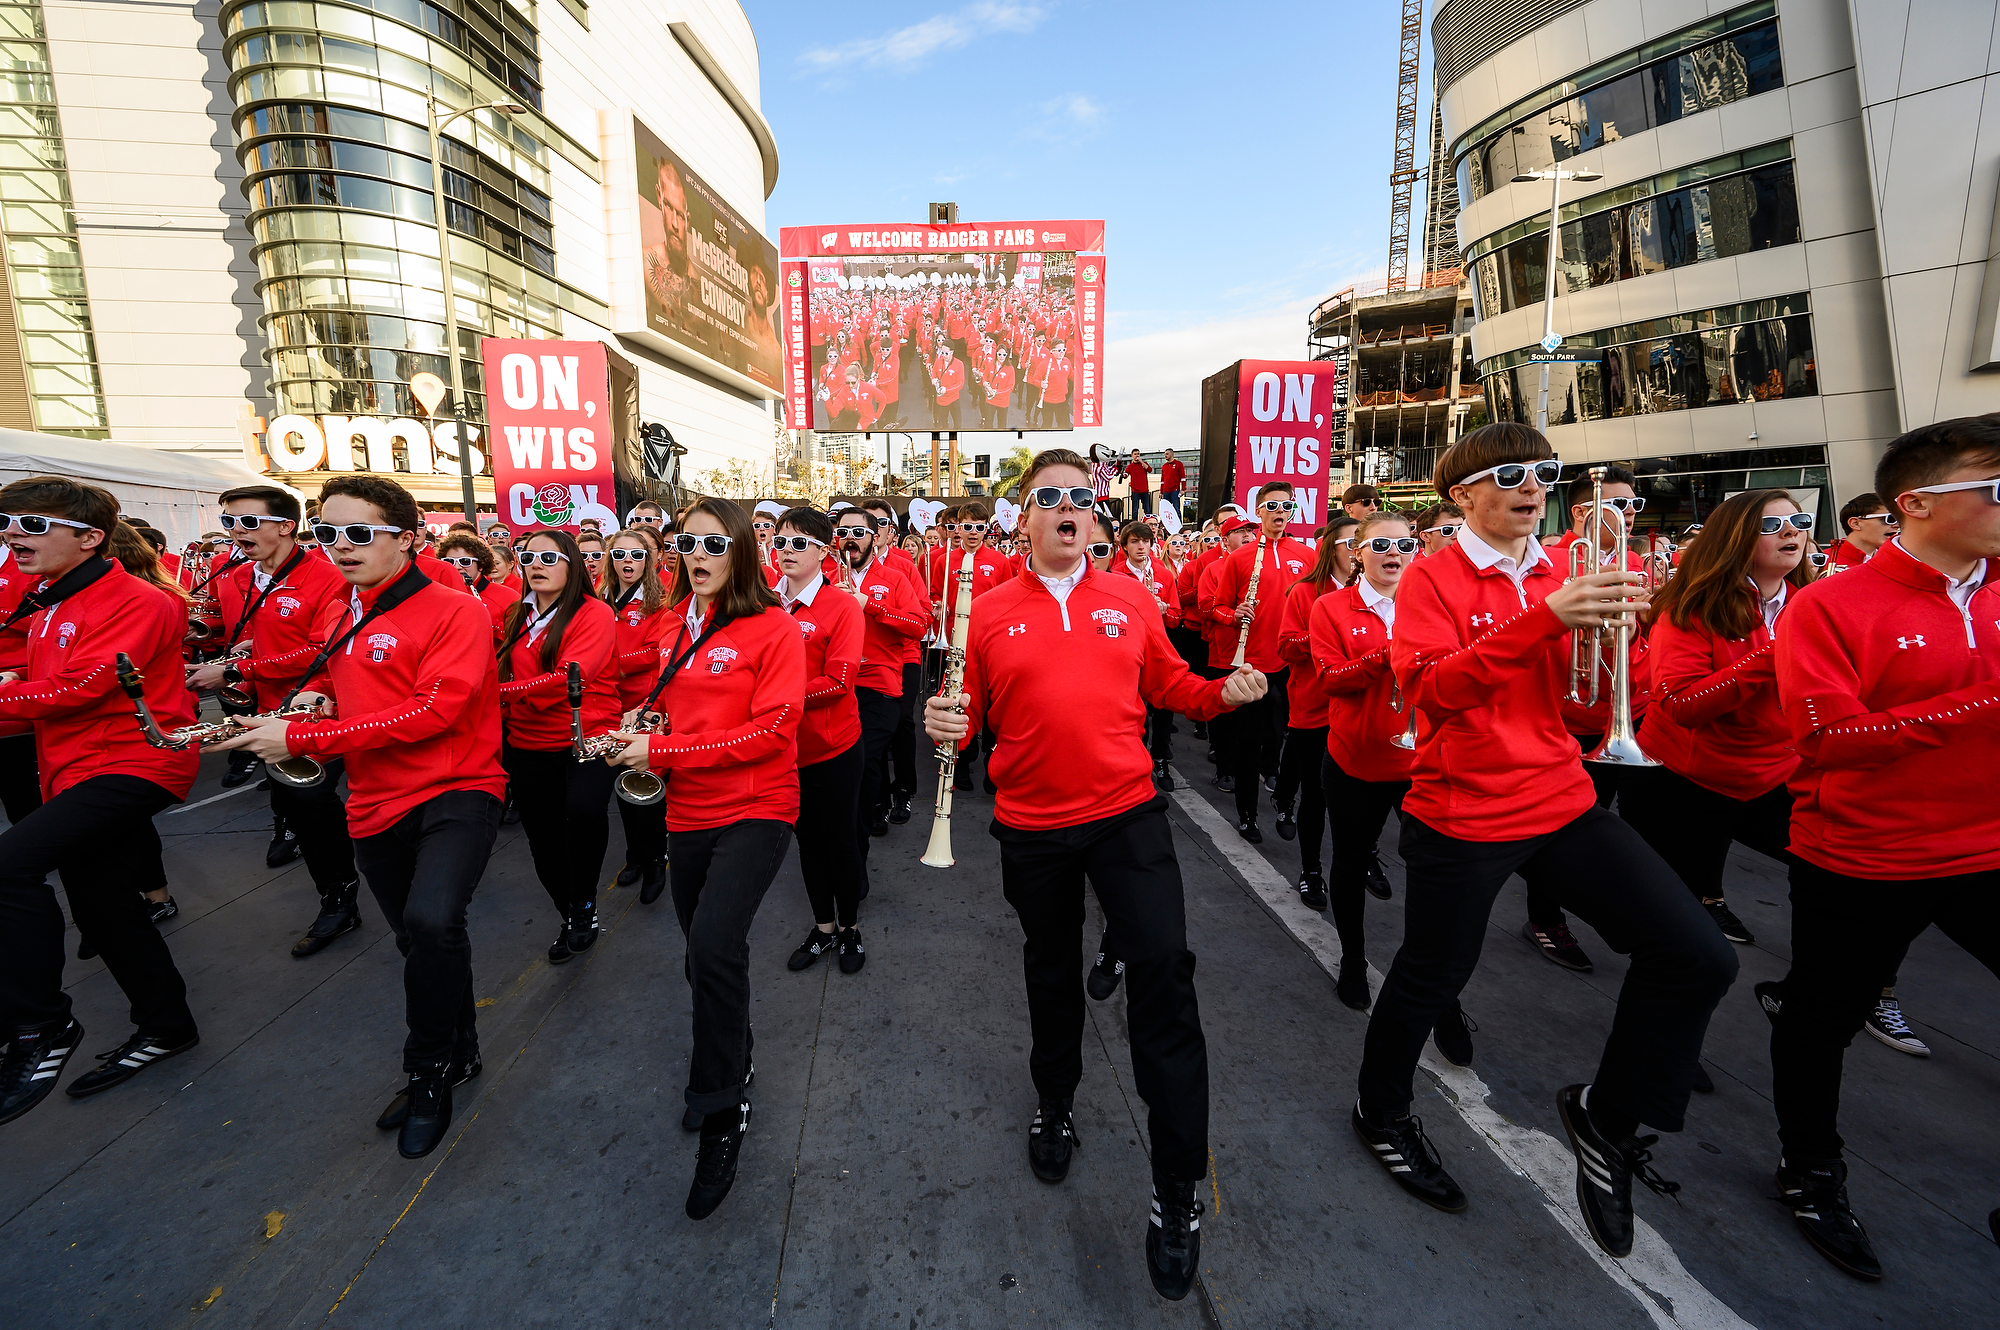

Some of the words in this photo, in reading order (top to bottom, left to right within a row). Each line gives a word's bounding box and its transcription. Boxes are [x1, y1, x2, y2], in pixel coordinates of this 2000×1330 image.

[715, 219, 727, 237] UFC
[848, 231, 922, 248] WELCOME
[928, 230, 988, 247] BADGER
[994, 229, 1035, 246] FANS
[812, 267, 839, 283] CN
[1020, 266, 1040, 279] CN
[688, 303, 706, 321] SATURDAY
[701, 276, 745, 329] COWBOY
[791, 296, 803, 321] 2020
[1084, 291, 1096, 322] ROSE
[656, 314, 668, 327] ESPN
[792, 325, 804, 358] GAME
[1083, 325, 1095, 358] BOWL
[501, 353, 596, 418] ON,
[794, 361, 805, 394] BOWL
[1083, 363, 1094, 395] GAME
[795, 397, 806, 426] ROSE
[1082, 398, 1094, 424] 2020
[1252, 372, 1323, 429] ON,
[504, 426, 597, 471] WIS
[1249, 436, 1319, 475] WIS
[509, 483, 598, 526] CN
[1091, 609, 1128, 624] WISCONSIN
[368, 633, 398, 648] WISCONSIN
[708, 647, 738, 660] WISCONSIN
